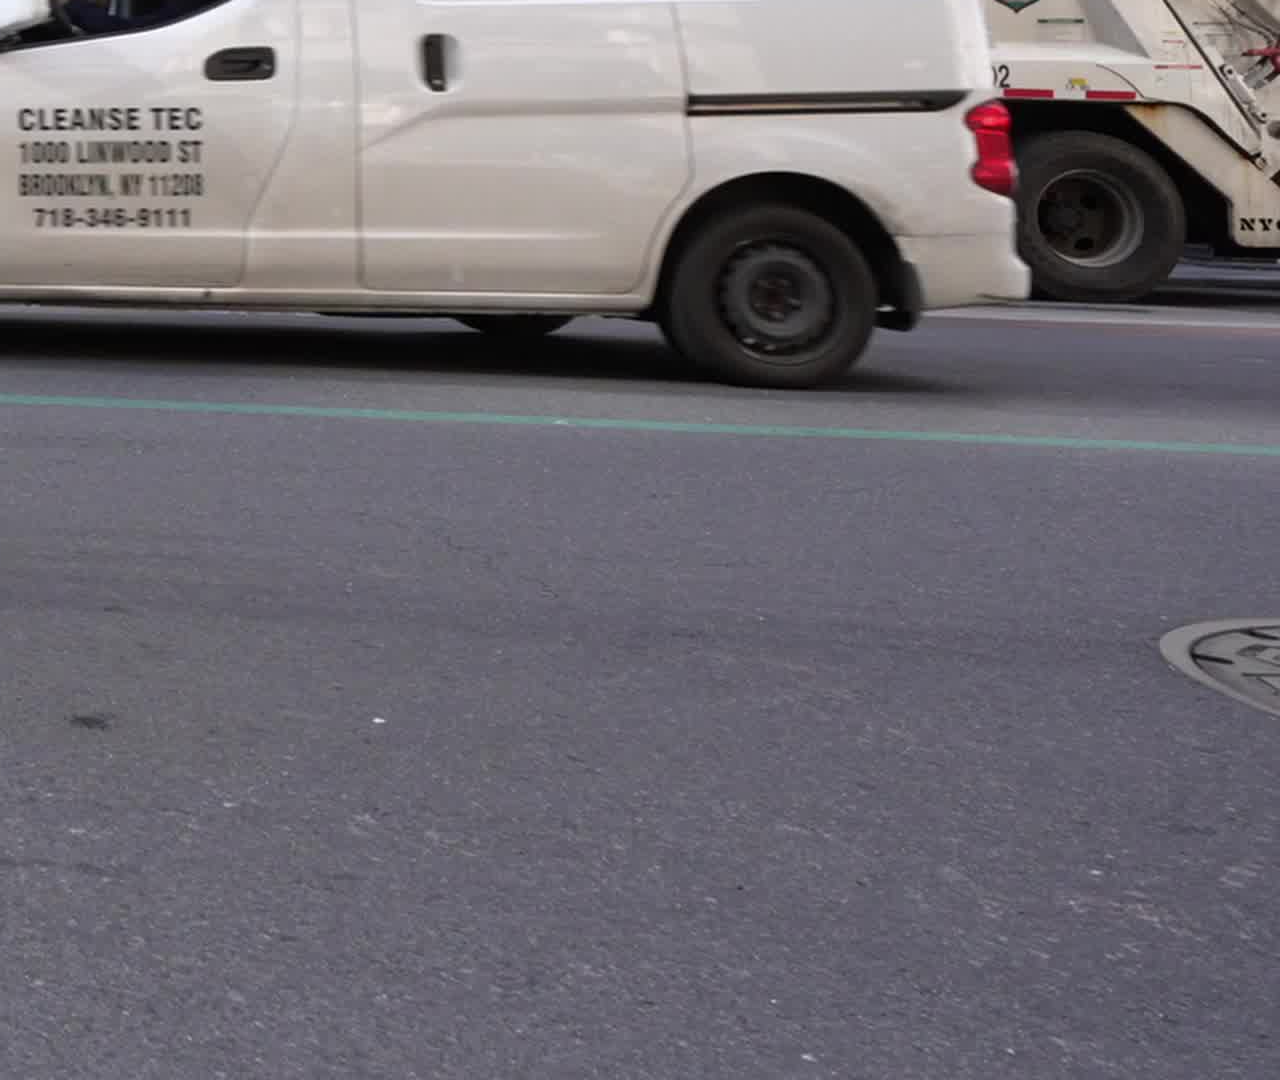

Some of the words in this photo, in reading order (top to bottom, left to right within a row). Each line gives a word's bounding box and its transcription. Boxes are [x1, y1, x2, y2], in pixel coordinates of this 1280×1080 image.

[18, 108, 140, 131] CLEANSE
[149, 108, 203, 131] TEC
[178, 141, 203, 163] ST
[1239, 218, 1280, 232] NY
